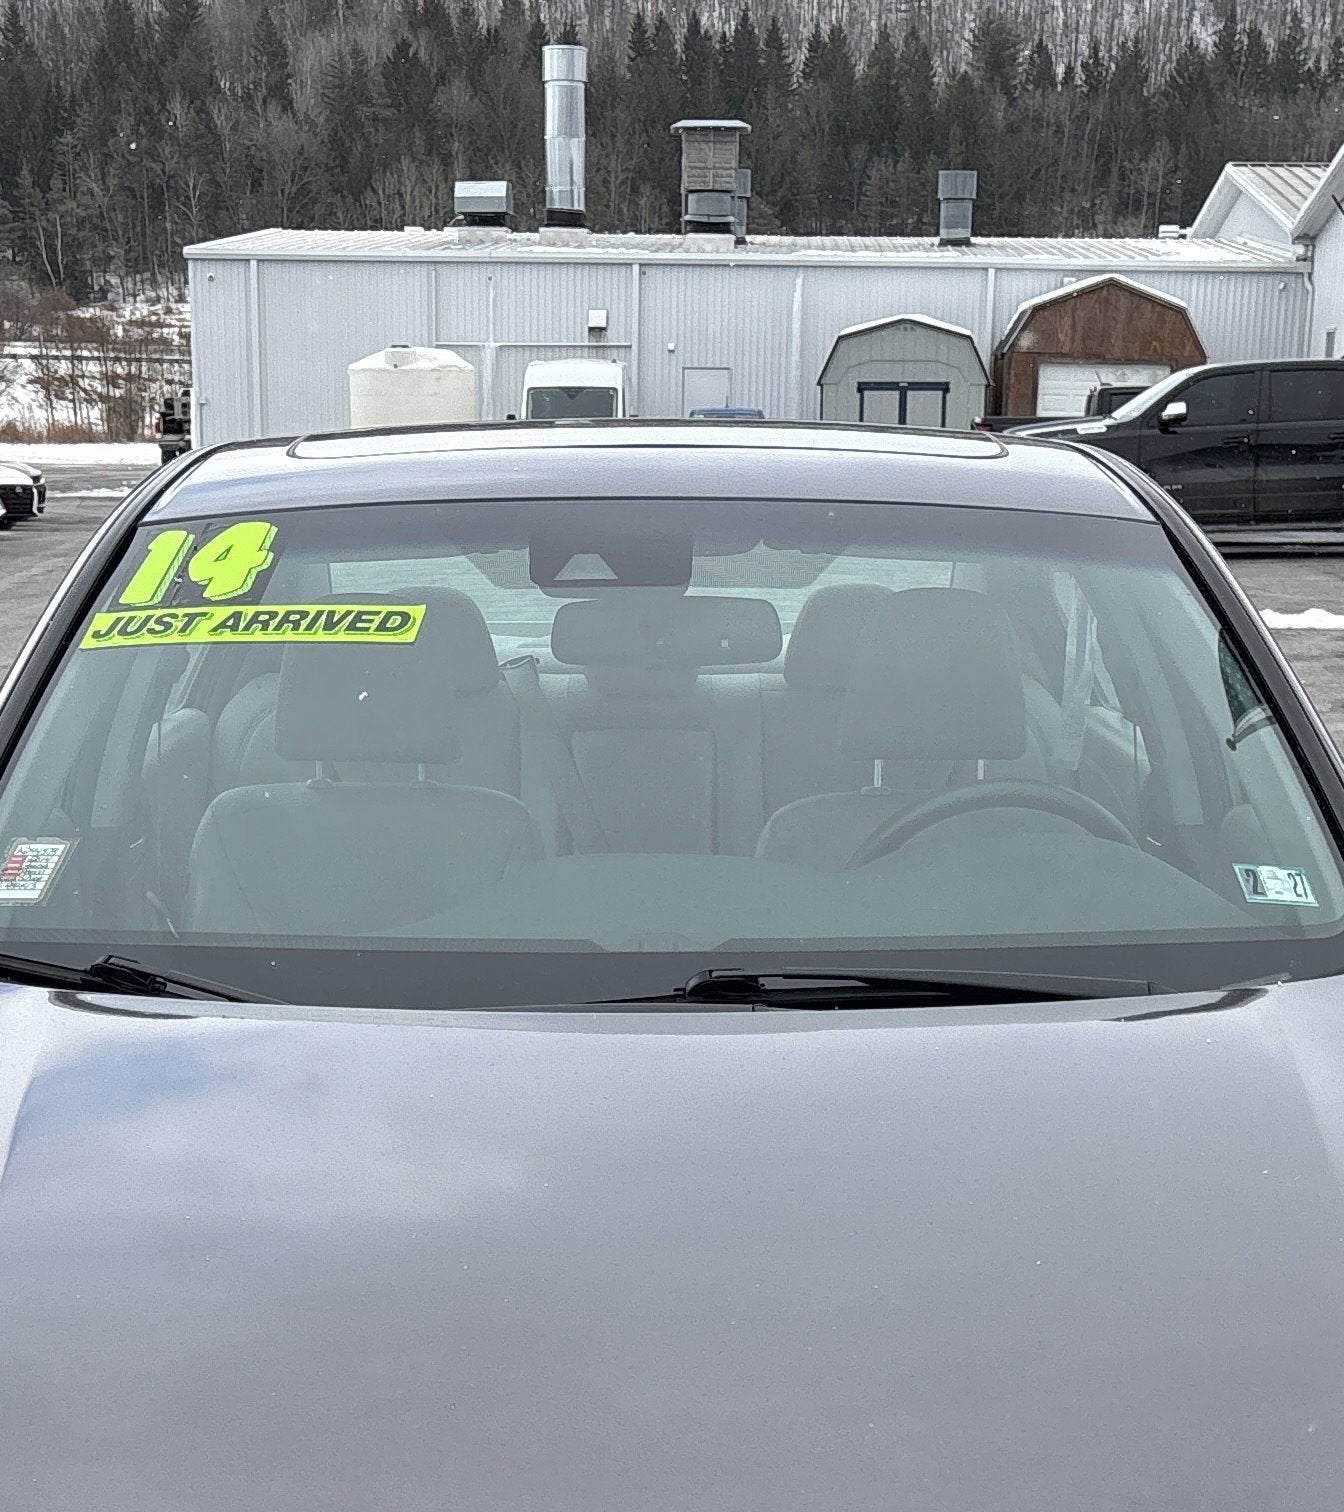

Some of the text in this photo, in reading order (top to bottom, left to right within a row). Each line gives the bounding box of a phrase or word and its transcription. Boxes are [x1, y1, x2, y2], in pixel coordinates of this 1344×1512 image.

[118, 521, 279, 607] 14
[90, 609, 417, 641] JUST ARRIVED
[1243, 868, 1265, 896] 2
